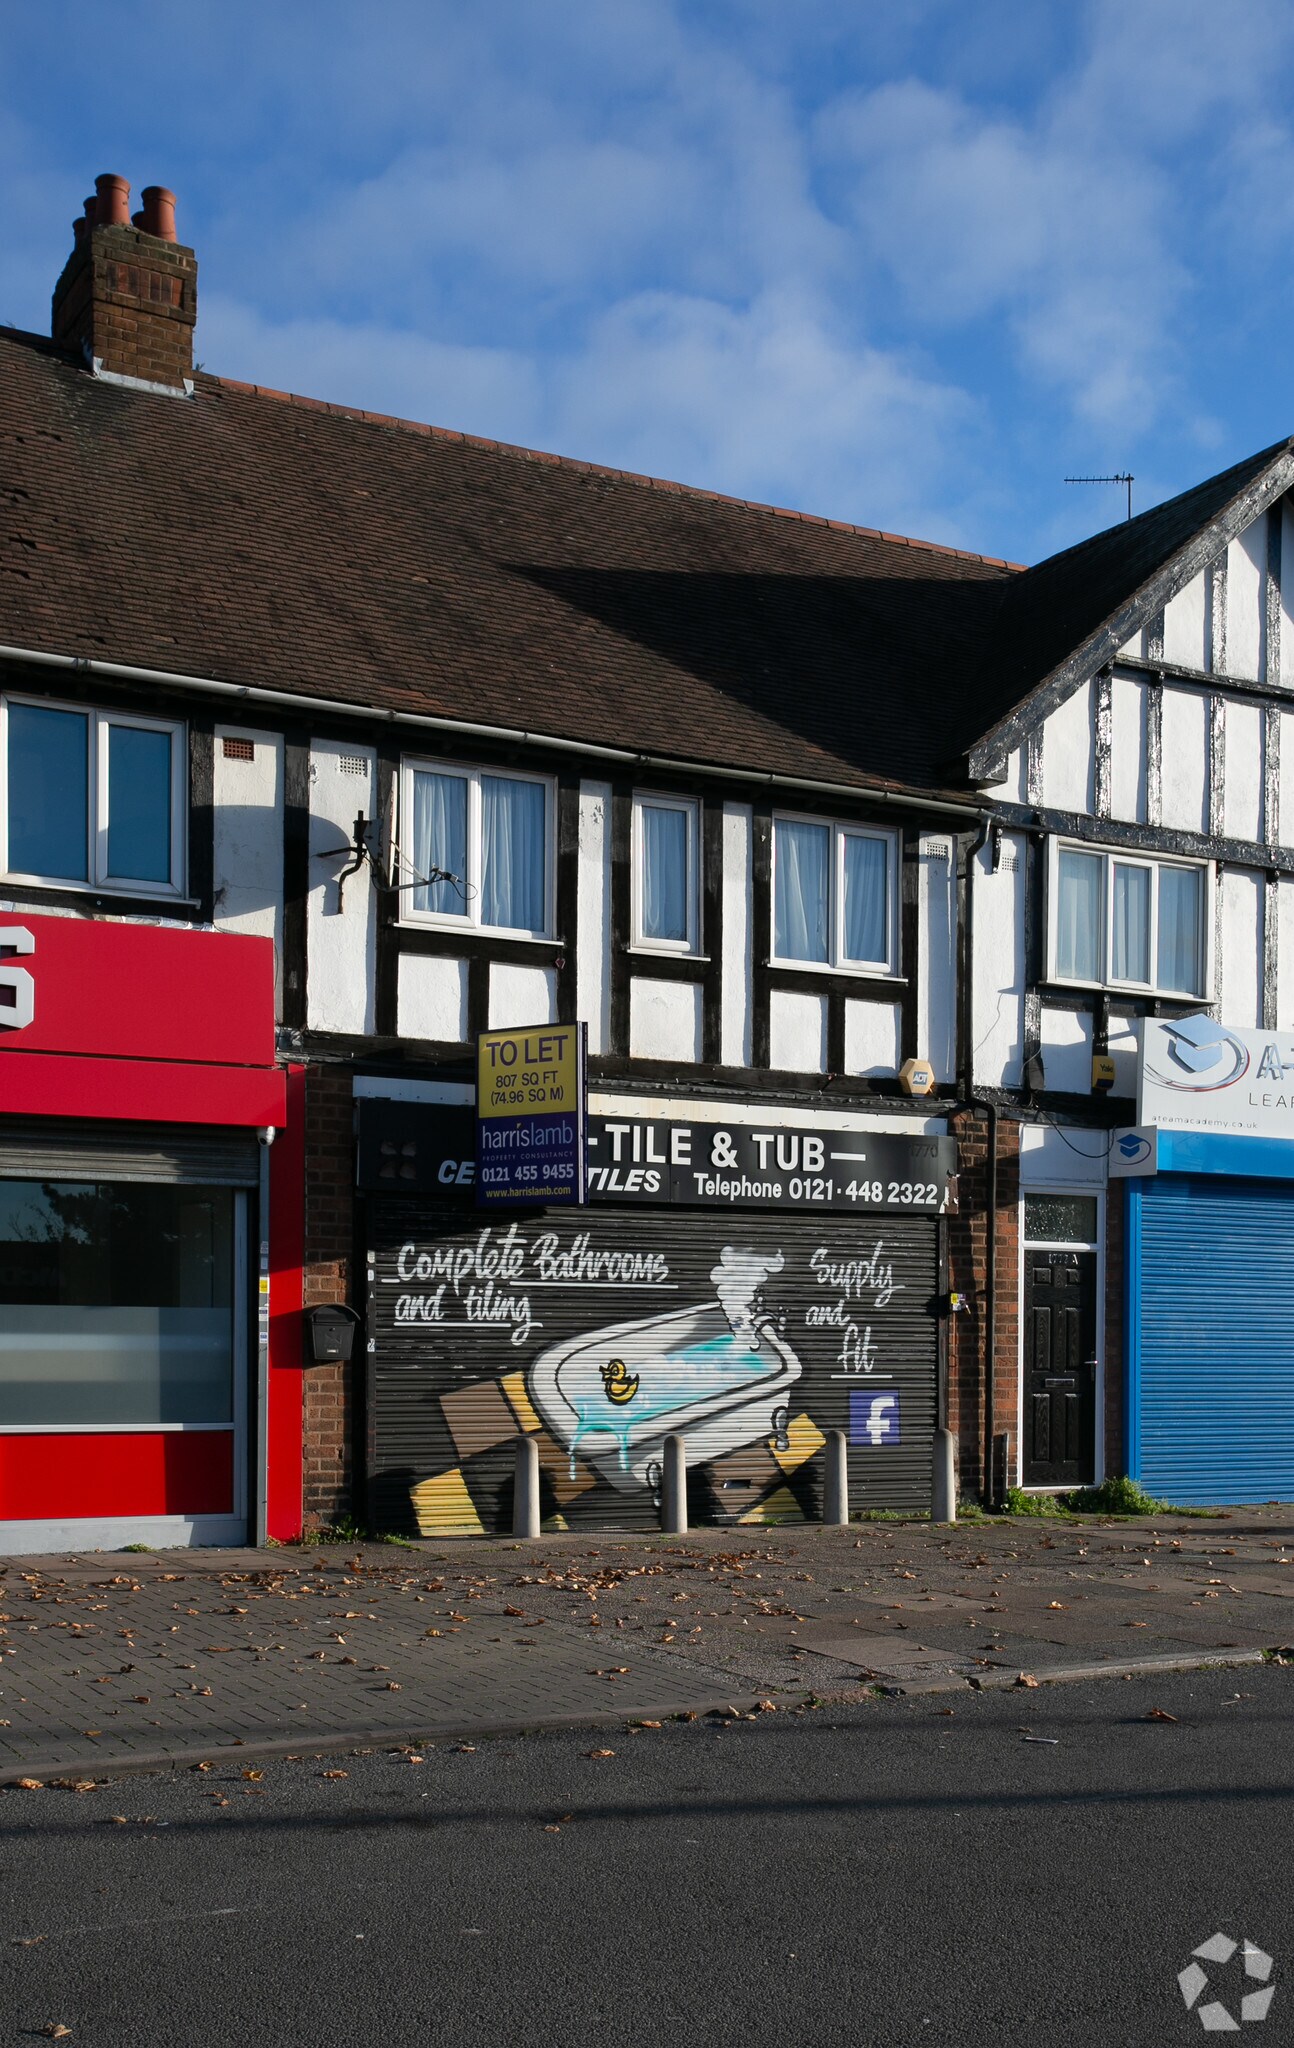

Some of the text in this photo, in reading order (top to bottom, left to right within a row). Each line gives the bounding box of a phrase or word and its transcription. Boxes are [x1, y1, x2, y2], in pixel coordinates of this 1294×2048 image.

[486, 1035, 568, 1067] TO LET
[495, 1070, 558, 1088] 807 SQ FT
[912, 1073, 927, 1083] ADT
[1100, 1064, 1114, 1073] Yale
[490, 1085, 564, 1106] (74.96 SQ M)
[1152, 1114, 1258, 1129] ateamacademy.co.uk
[482, 1120, 574, 1149] harrislamb
[520, 1150, 574, 1160] CONSULTANCY
[711, 1131, 739, 1168] &
[482, 1163, 574, 1183] 0121 455 9455
[485, 1186, 571, 1198] www.harrislamb.com
[693, 1172, 782, 1201] Telephone
[887, 1182, 938, 1205] 2322
[397, 1223, 669, 1296] Complete Bathrooms
[809, 1240, 905, 1307] Supply
[394, 1280, 543, 1346] and tiling
[805, 1299, 850, 1326] and
